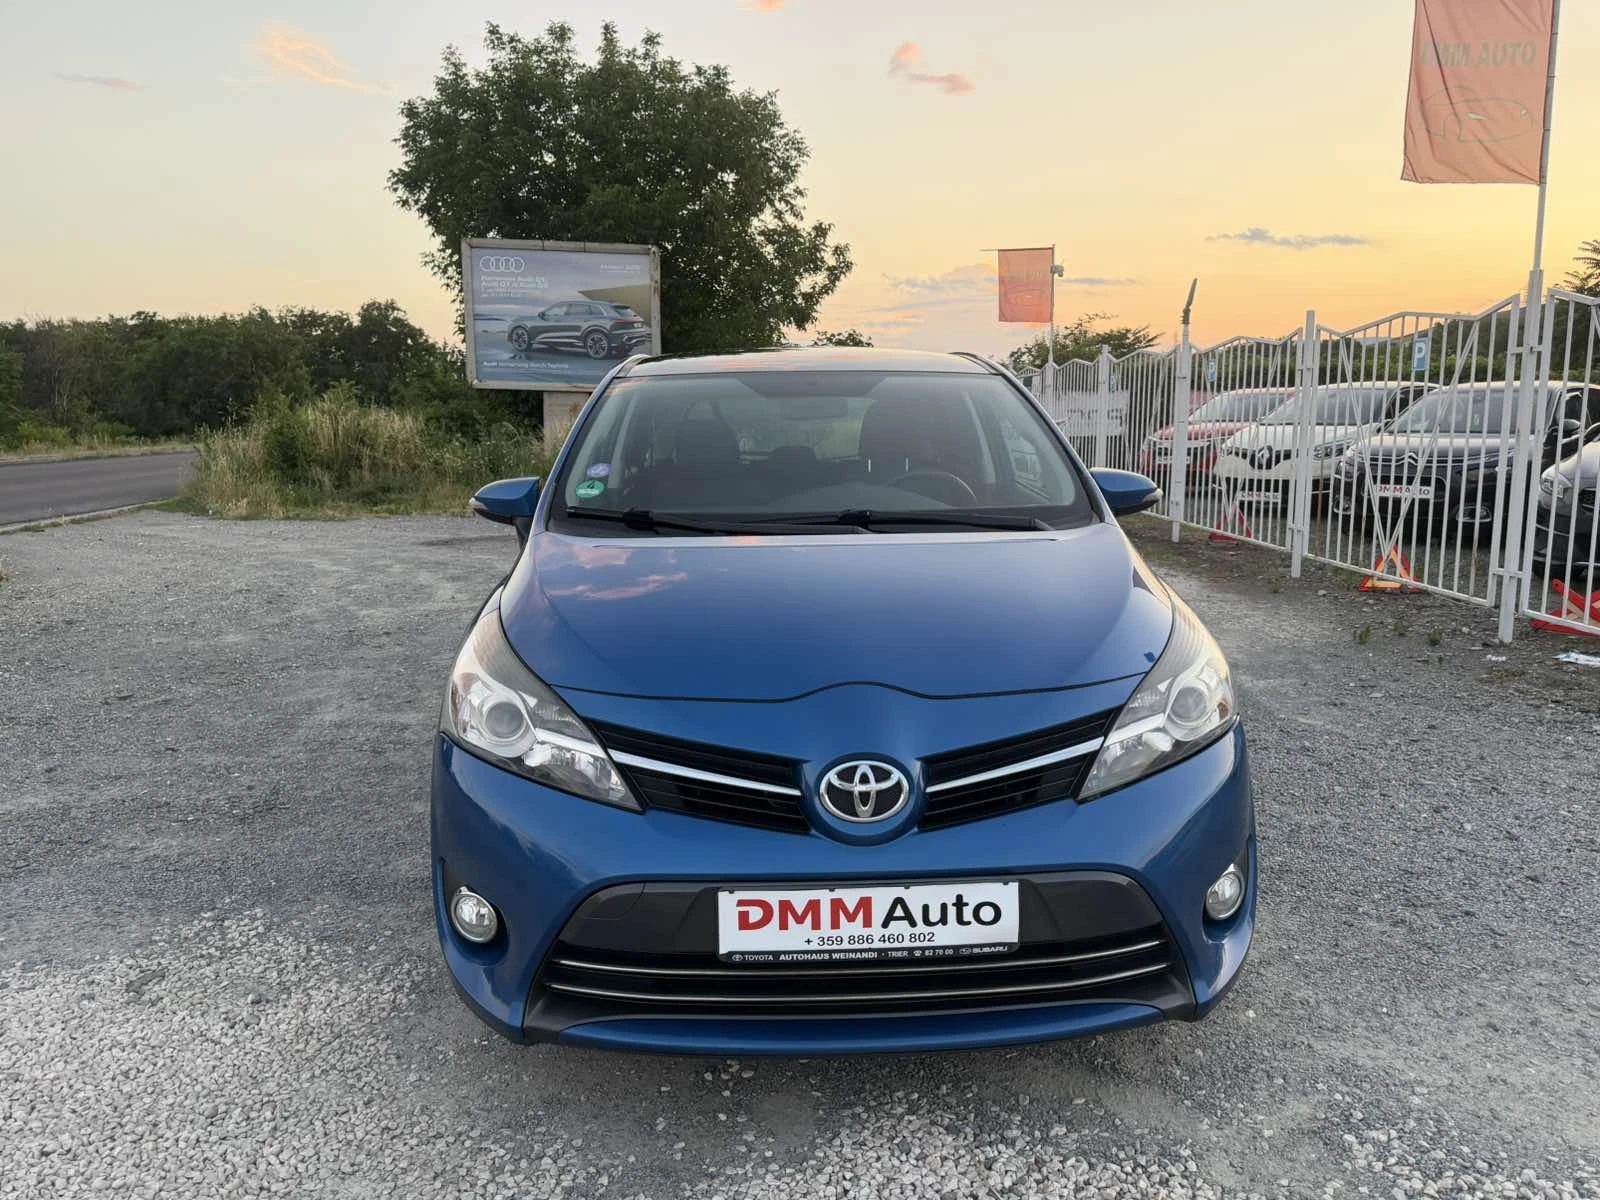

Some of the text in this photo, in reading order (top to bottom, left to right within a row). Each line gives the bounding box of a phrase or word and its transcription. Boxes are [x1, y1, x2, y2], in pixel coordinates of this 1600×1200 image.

[1478, 41, 1536, 66] AUTO
[736, 894, 1002, 931] DMM Auto
[847, 934, 874, 945] 886
[878, 933, 905, 944] 460
[909, 932, 935, 943] 802
[779, 953, 830, 961] AUTOHAUS
